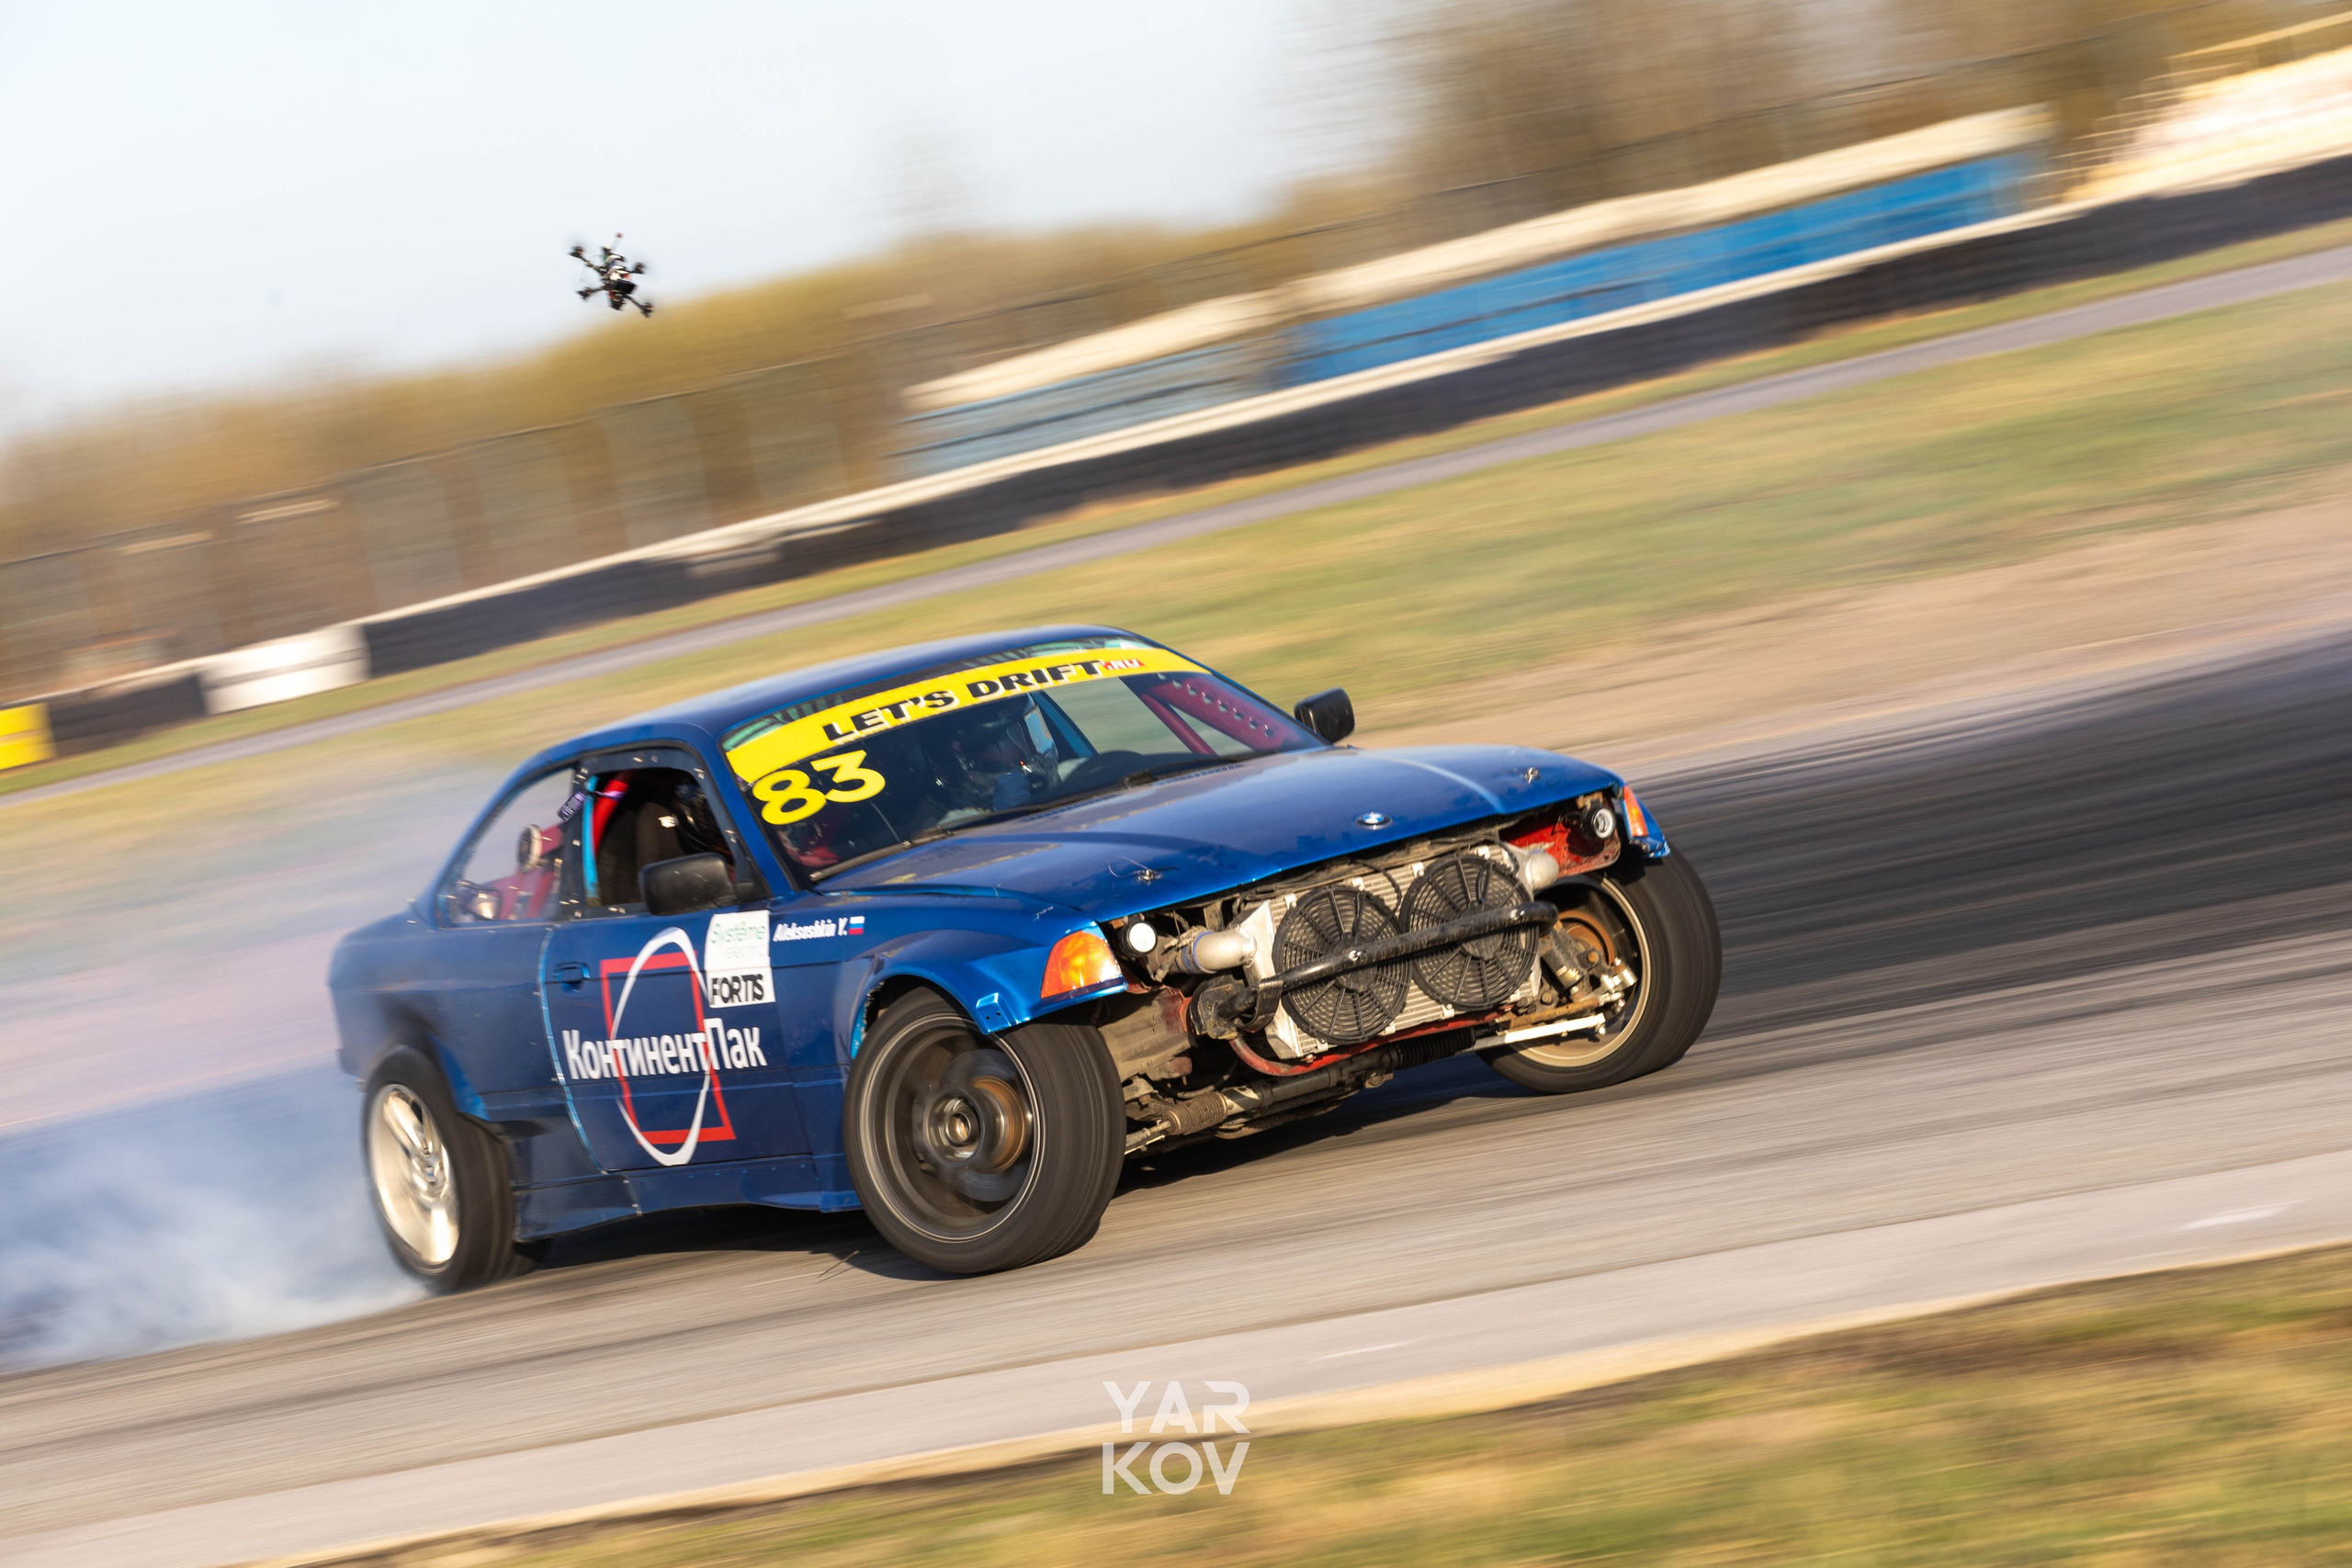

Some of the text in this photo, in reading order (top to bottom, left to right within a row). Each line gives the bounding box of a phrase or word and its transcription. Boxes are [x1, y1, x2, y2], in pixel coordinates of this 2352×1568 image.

[822, 691, 956, 743] LET'S
[752, 749, 886, 826] 83
[838, 917, 849, 937] Y.
[711, 974, 764, 1006] FORTIS
[561, 1018, 768, 1080] КонтинентПак
